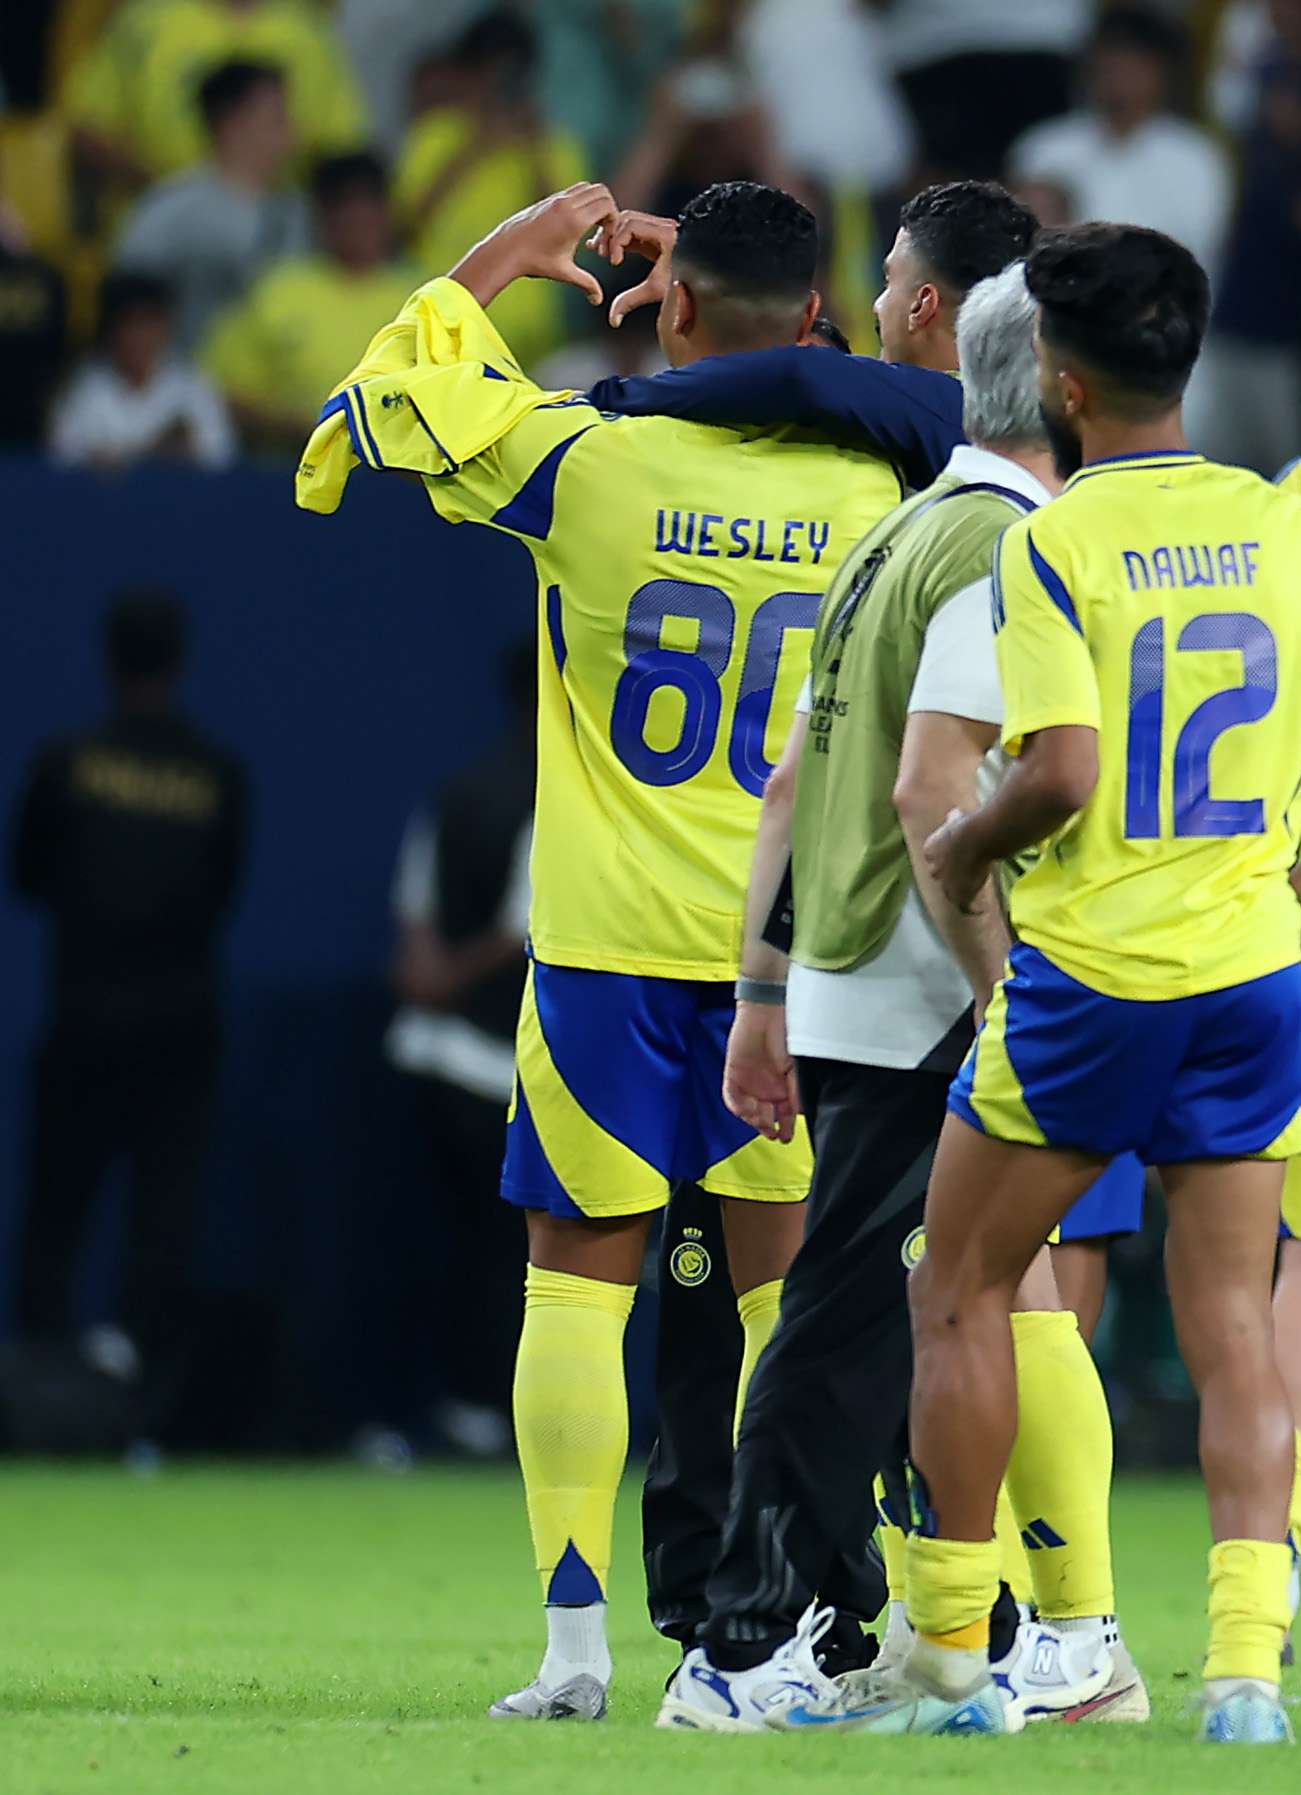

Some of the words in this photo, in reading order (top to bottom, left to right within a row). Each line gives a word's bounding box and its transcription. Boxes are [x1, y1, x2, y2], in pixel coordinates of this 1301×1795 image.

[655, 509, 829, 564] WESLEY
[1122, 542, 1260, 590] NAWAF
[1124, 612, 1277, 839] 12
